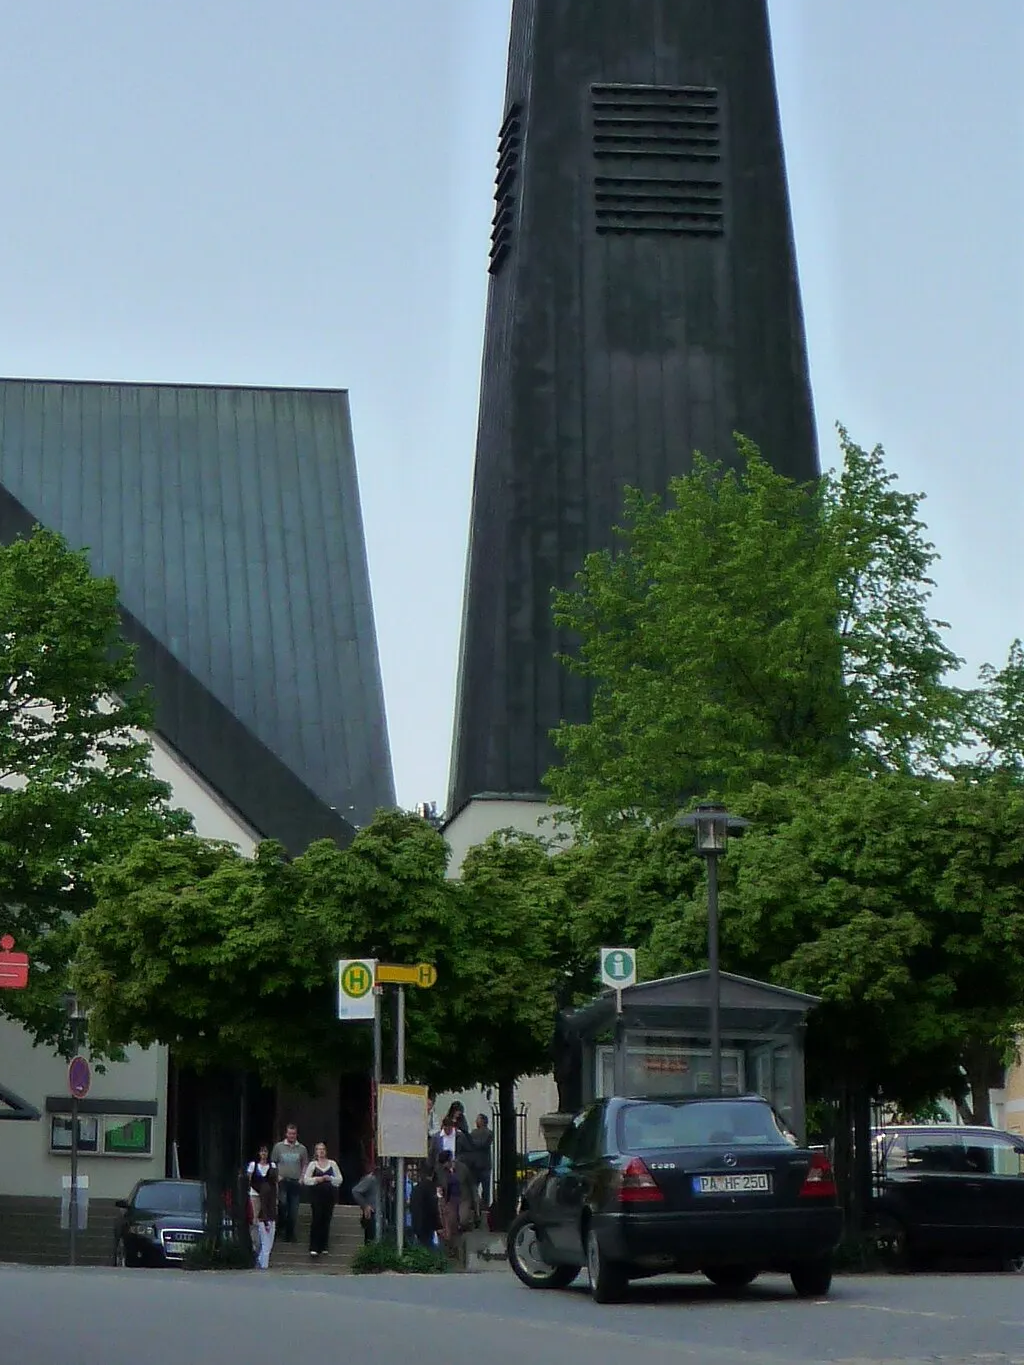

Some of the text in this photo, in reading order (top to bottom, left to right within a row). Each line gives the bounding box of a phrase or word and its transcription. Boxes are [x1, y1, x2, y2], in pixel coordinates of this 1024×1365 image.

[349, 969, 365, 990] H
[701, 1175, 766, 1191] PA HF 250
